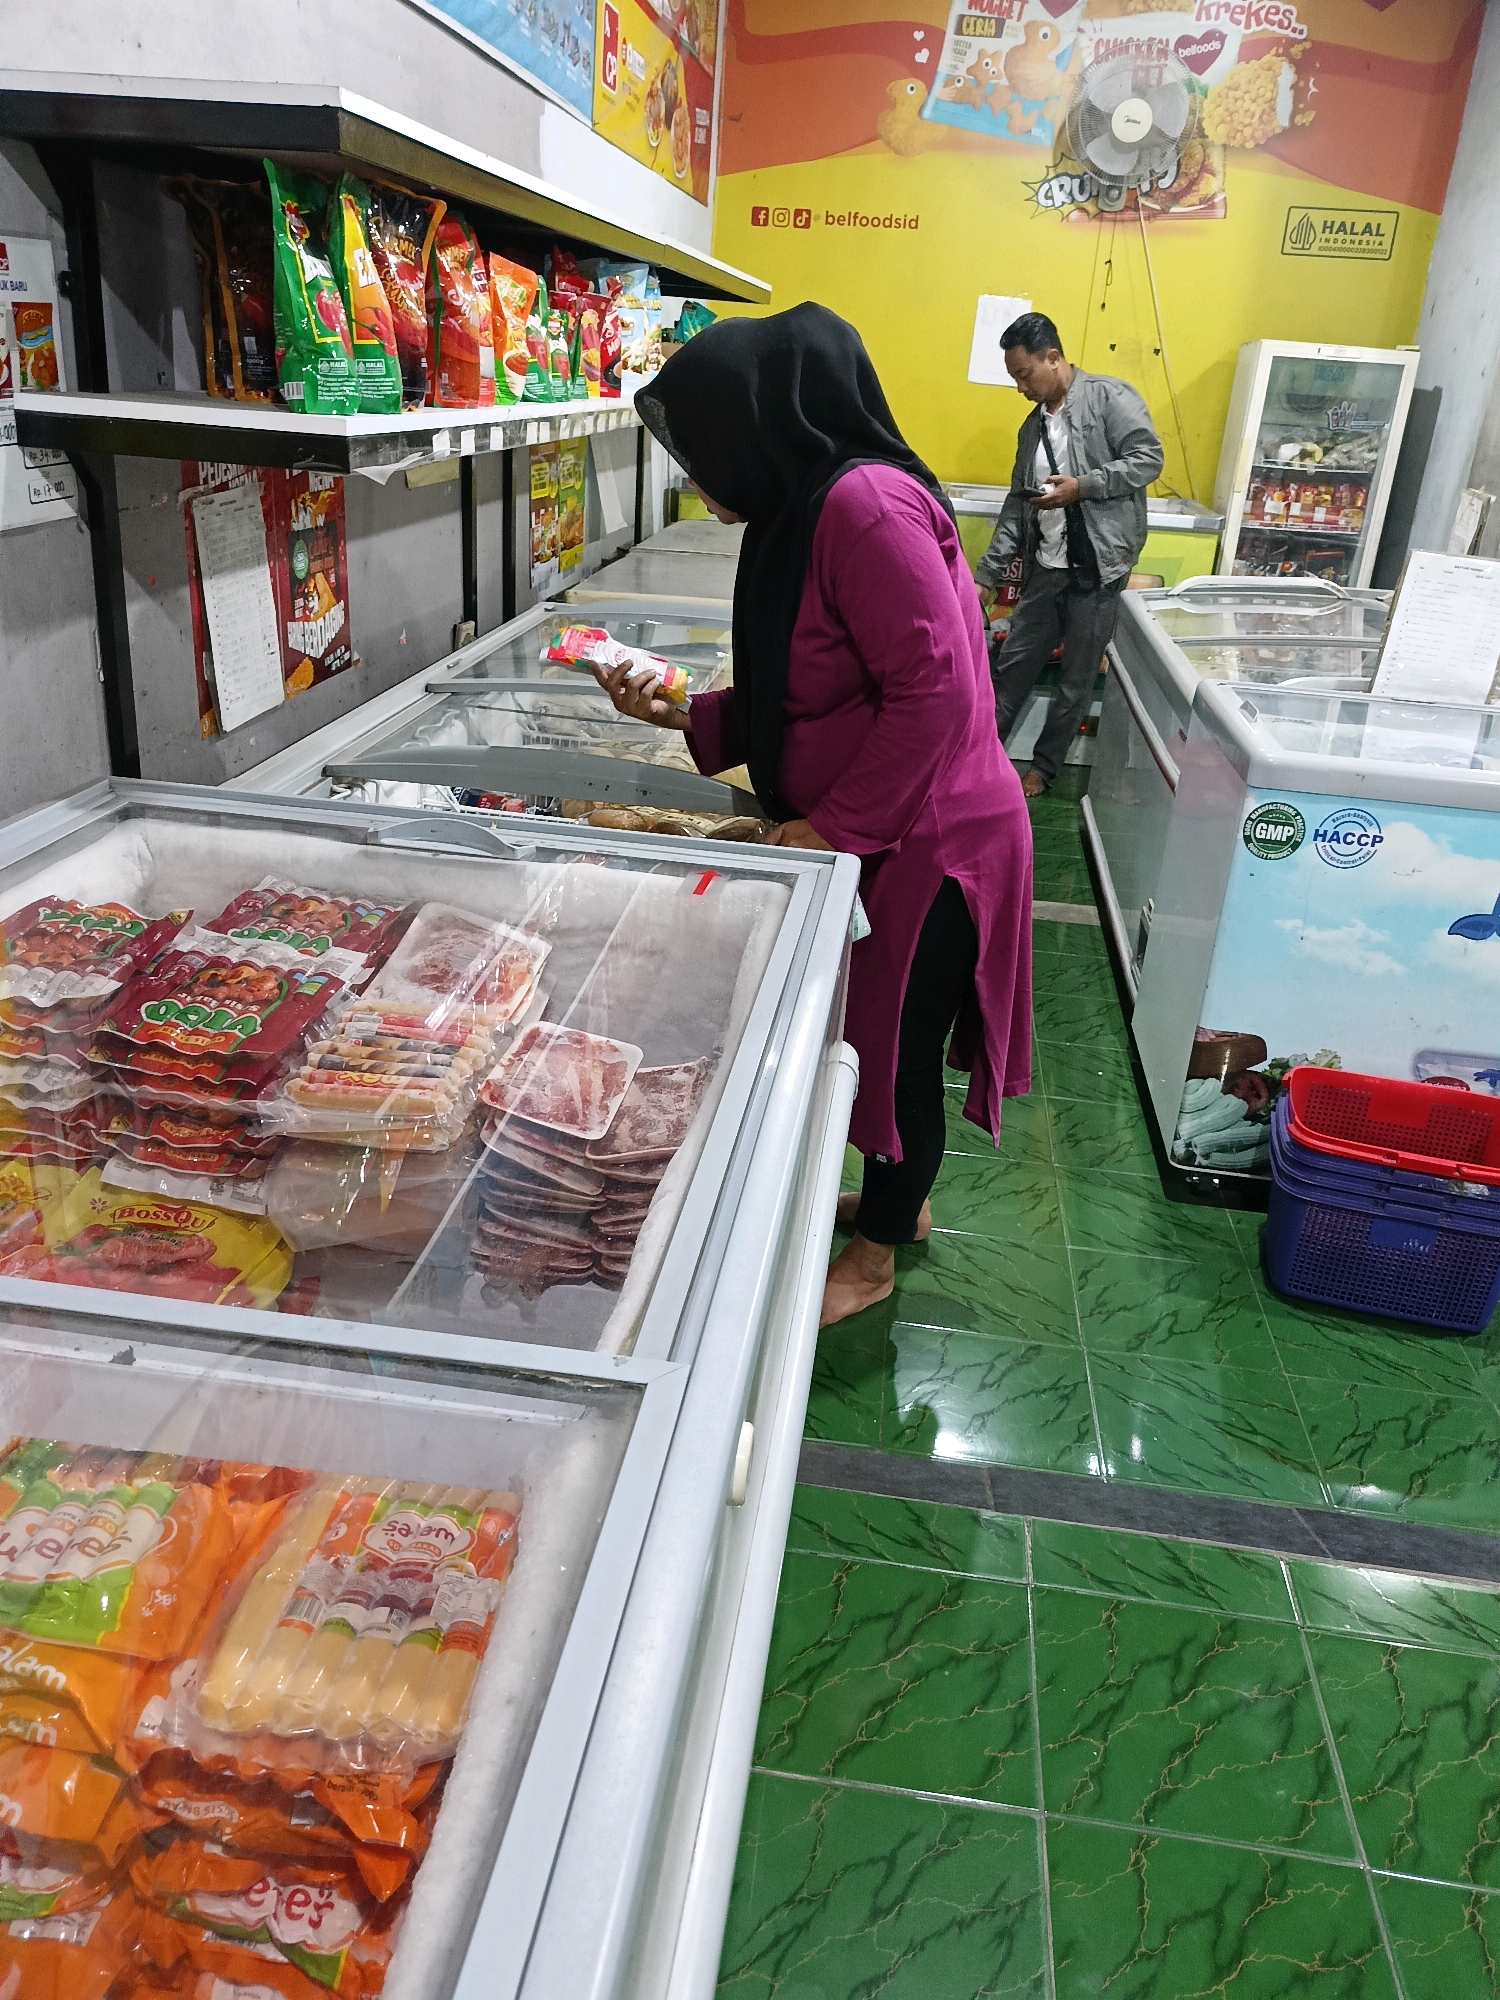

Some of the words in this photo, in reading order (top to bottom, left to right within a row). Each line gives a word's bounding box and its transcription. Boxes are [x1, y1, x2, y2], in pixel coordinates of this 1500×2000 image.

[1179, 39, 1221, 58] belfoods
[824, 210, 920, 230] belfoodsid
[1321, 220, 1386, 238] HALAL
[1319, 237, 1384, 247] INDONESIA
[10, 281, 28, 292] BARU
[1250, 803, 1297, 820] MANUFACTURING
[1255, 823, 1295, 842] GMP
[1313, 828, 1385, 848] HACCP
[1247, 842, 1268, 859] QUALITY
[1267, 848, 1293, 860] PRODUCT
